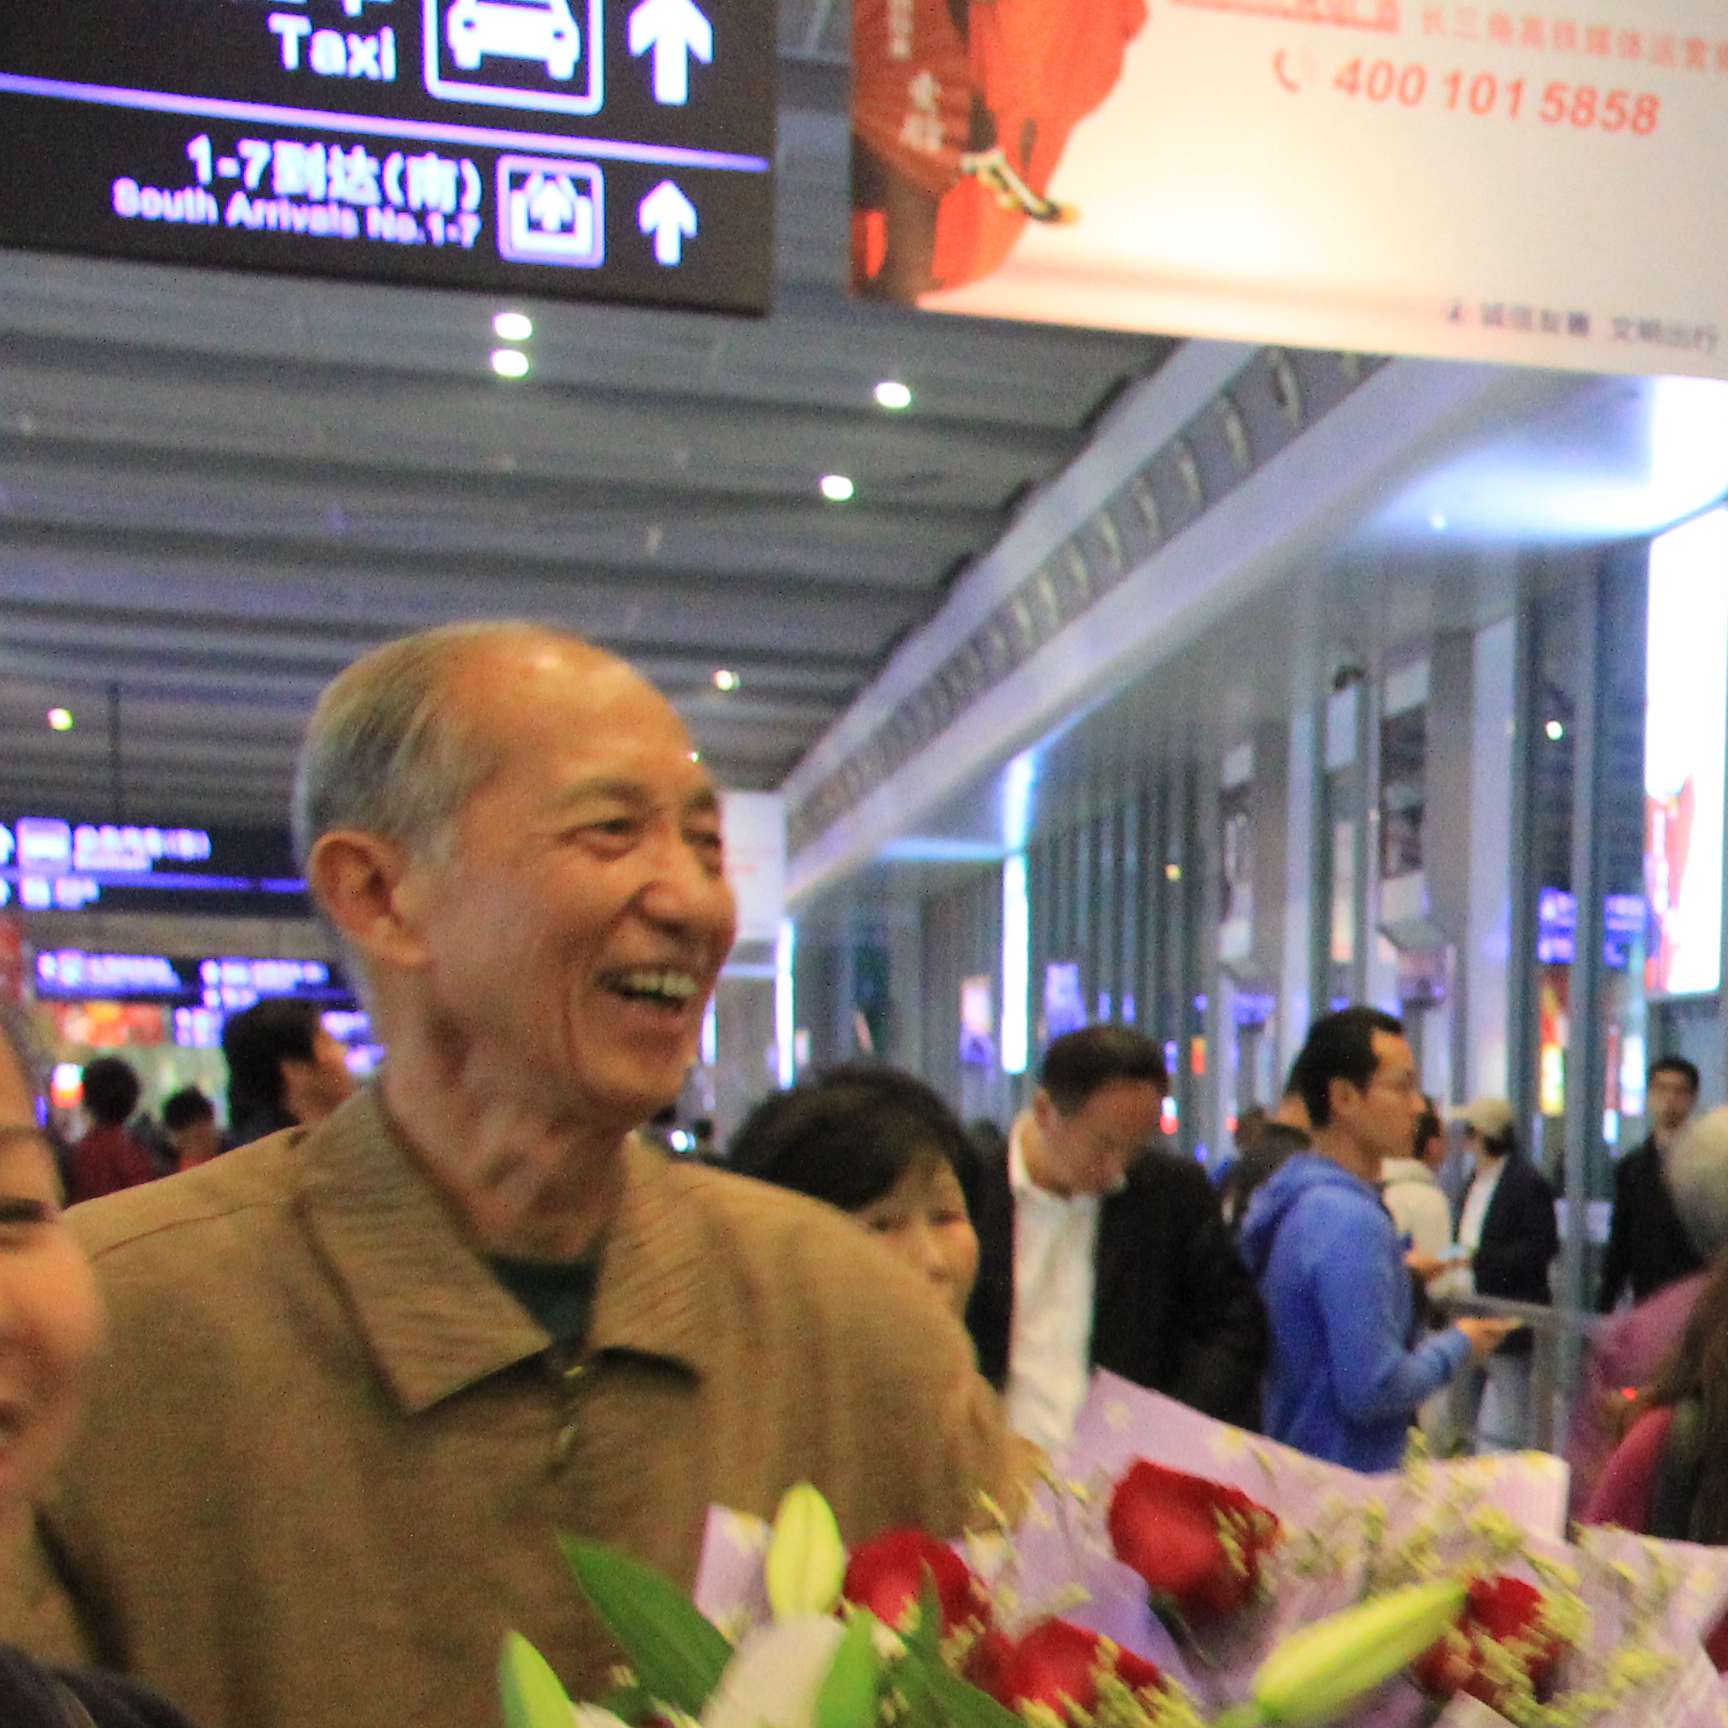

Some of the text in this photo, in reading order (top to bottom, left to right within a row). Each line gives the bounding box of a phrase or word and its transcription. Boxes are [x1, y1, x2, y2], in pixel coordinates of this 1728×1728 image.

[267, 12, 397, 82] Taxi
[1332, 57, 1661, 137] 400 101 5858
[112, 176, 219, 225] South
[224, 191, 359, 239] Arrivals
